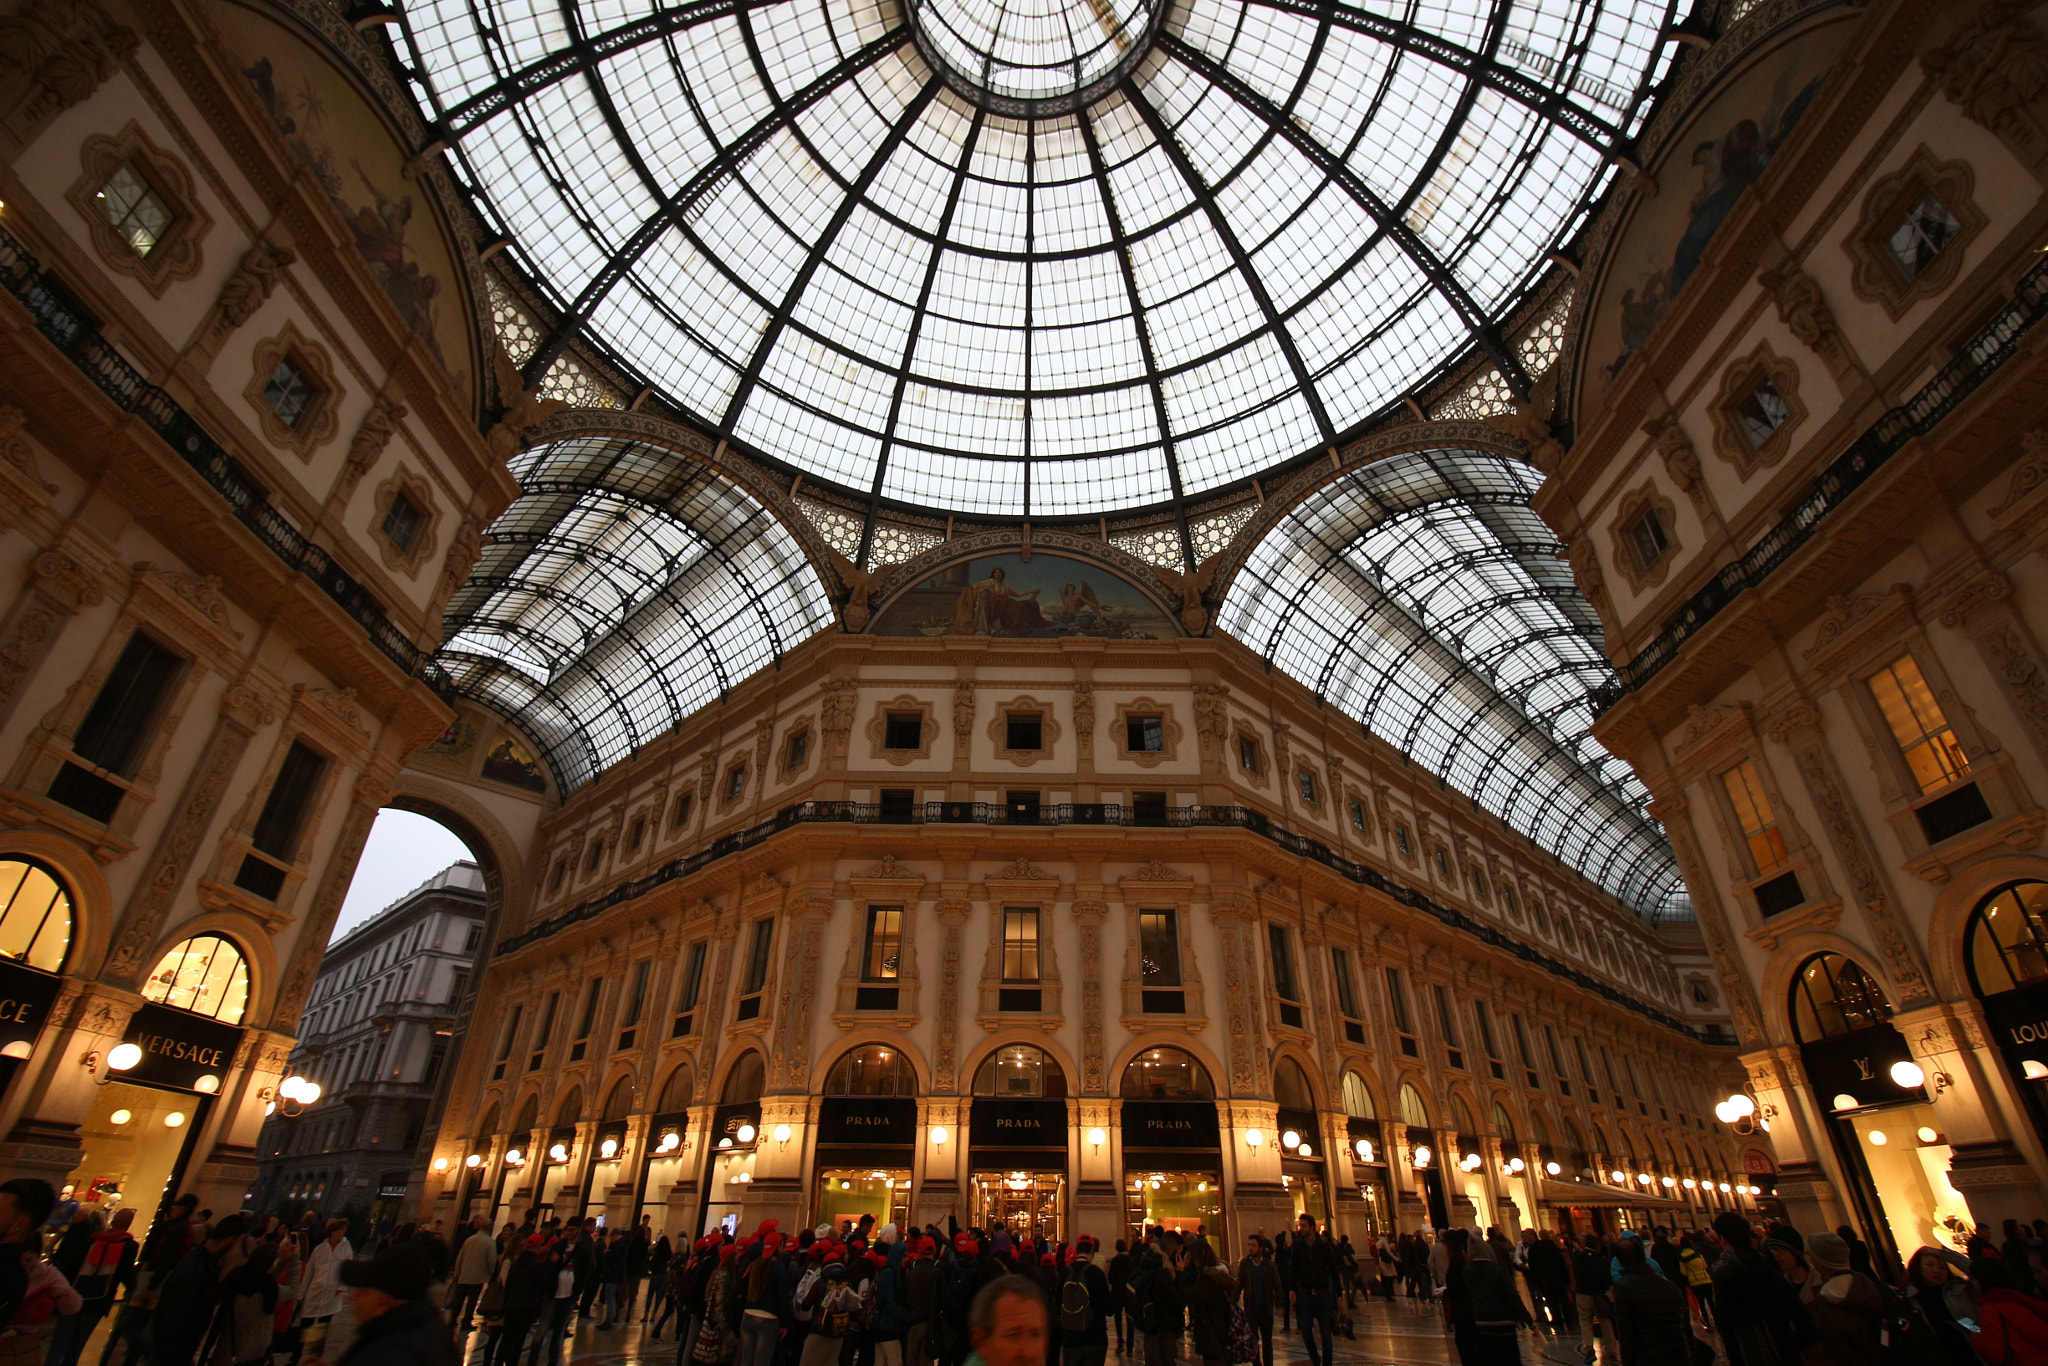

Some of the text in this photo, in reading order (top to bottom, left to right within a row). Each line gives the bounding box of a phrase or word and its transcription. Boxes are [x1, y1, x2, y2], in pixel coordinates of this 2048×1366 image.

[0, 999, 33, 1024] CE
[2010, 1021, 2048, 1045] LOU
[138, 1032, 224, 1067] VERSACE
[846, 1115, 890, 1126] PRADA
[996, 1118, 1041, 1128] PRADA
[1147, 1119, 1192, 1129] PRADA
